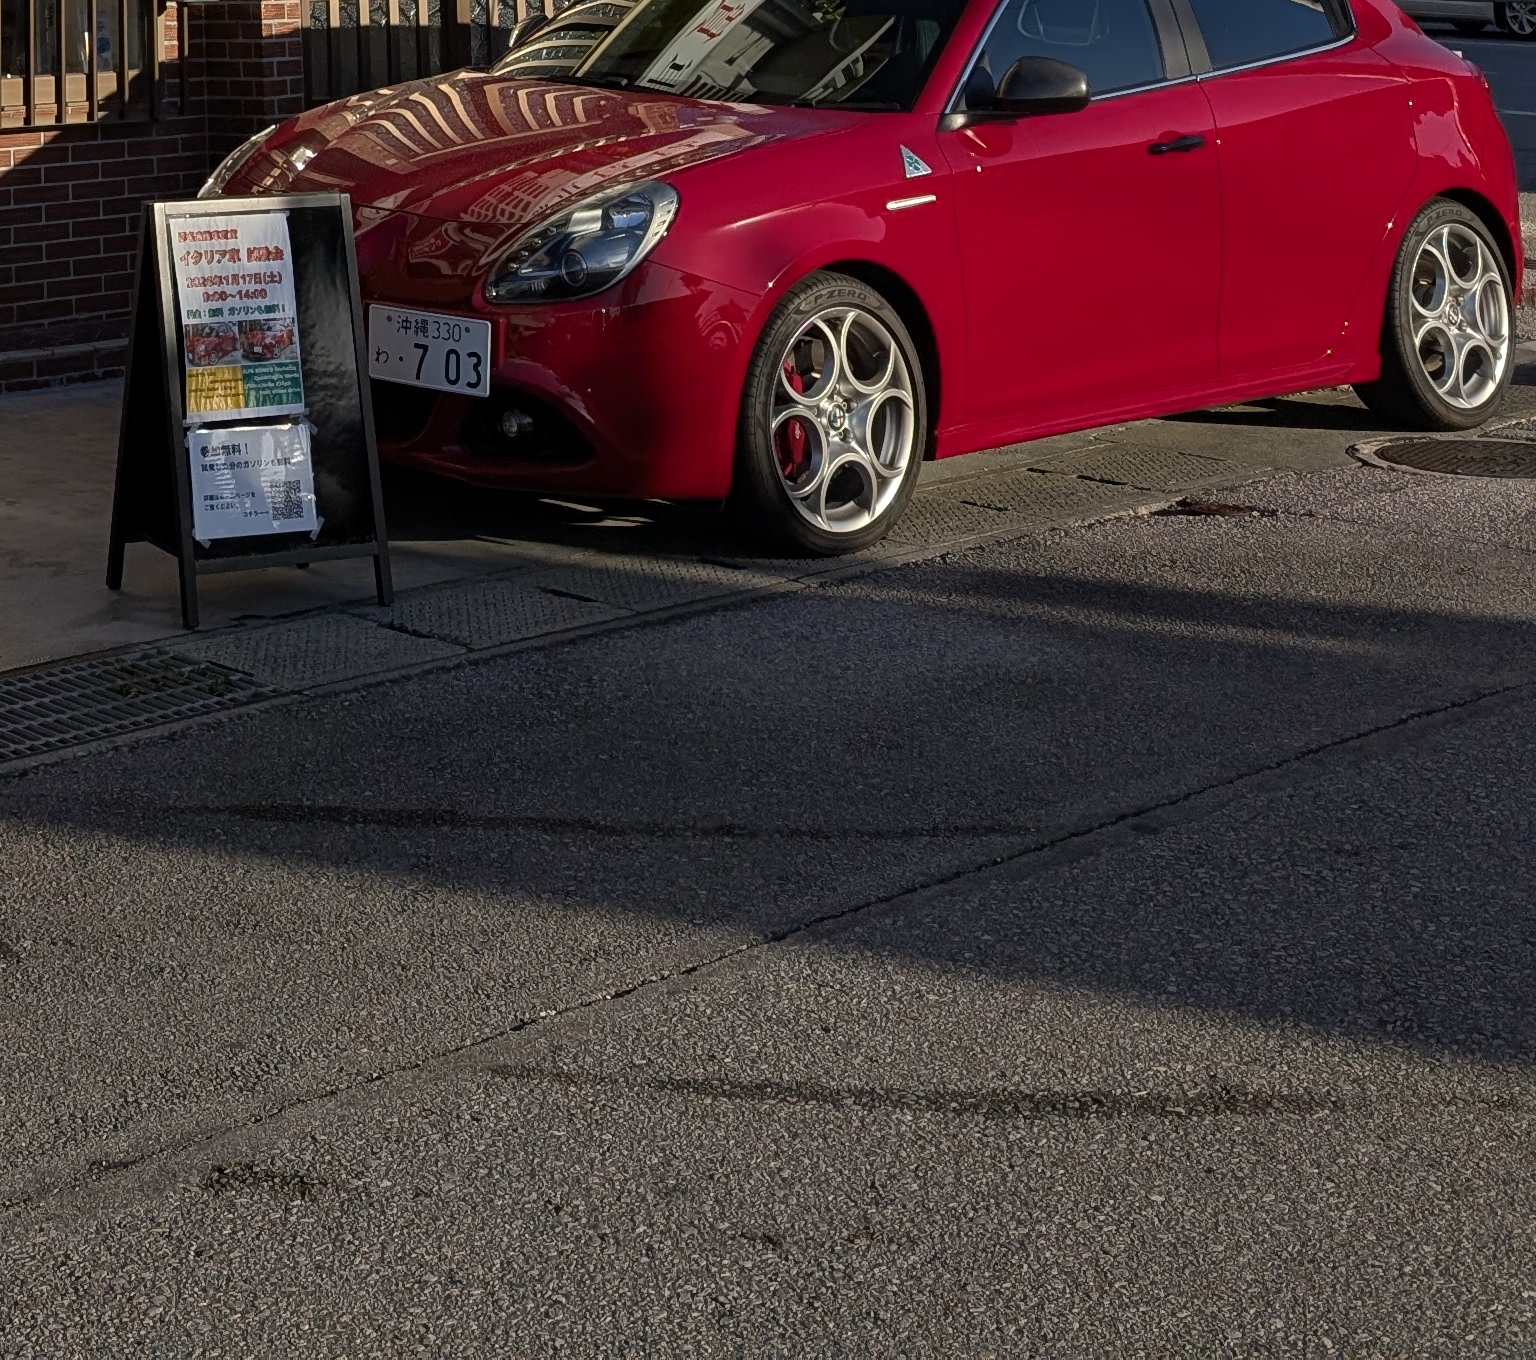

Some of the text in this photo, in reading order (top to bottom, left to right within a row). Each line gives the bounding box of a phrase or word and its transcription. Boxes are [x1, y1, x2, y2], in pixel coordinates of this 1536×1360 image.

[179, 247, 242, 267] イタリア車
[374, 345, 390, 364] わ
